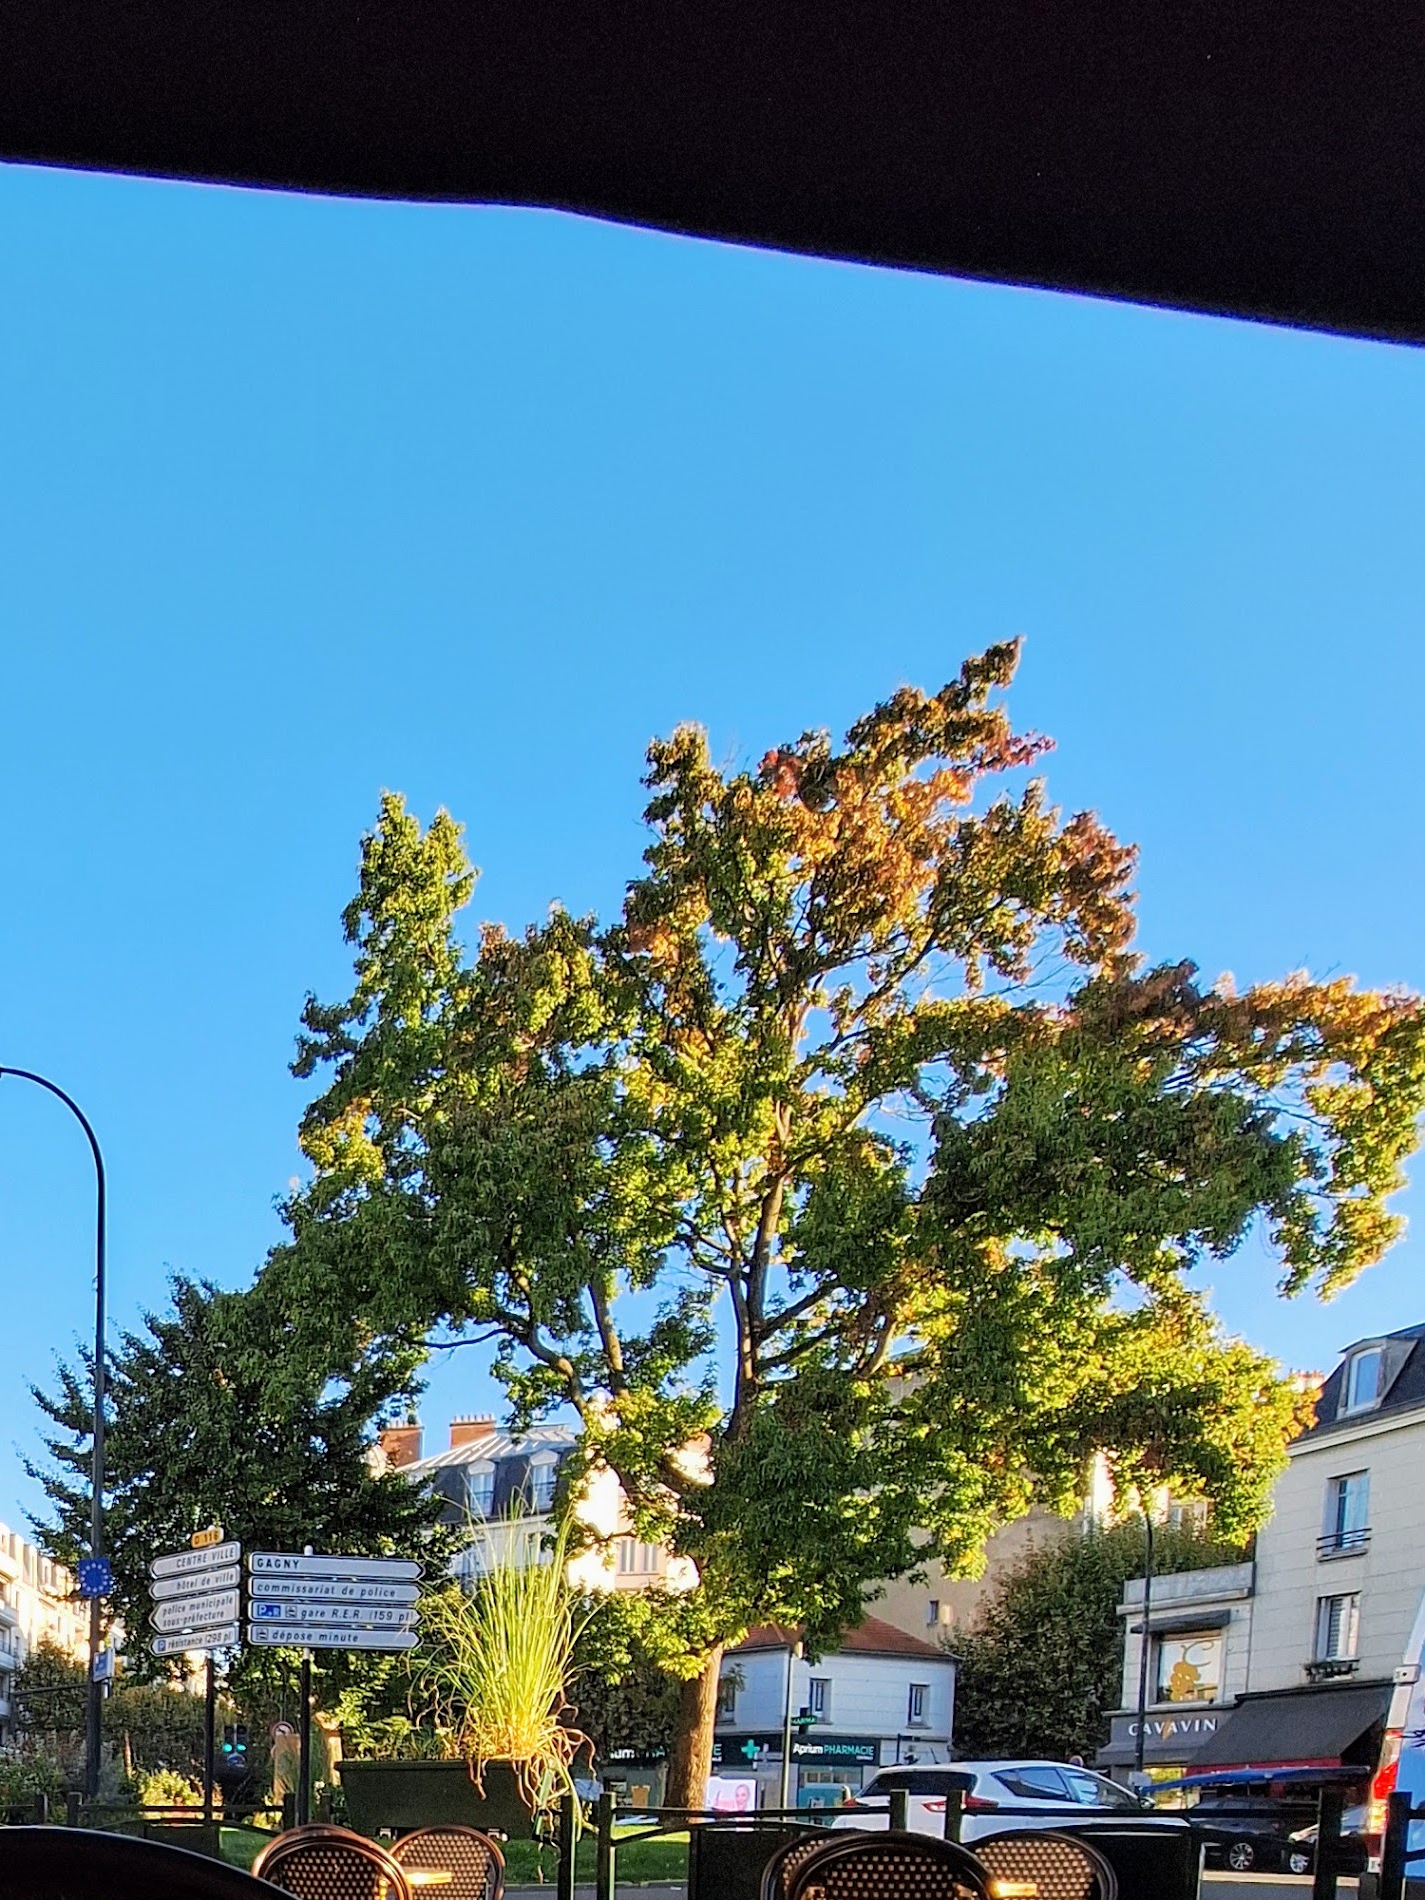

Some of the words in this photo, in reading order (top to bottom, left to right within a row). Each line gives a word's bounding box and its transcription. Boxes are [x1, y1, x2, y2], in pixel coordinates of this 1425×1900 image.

[177, 1553, 207, 1568] CENTRE
[212, 1547, 234, 1561] VILLE
[257, 1558, 299, 1569] GAGNY
[176, 1578, 198, 1591] hôtel
[201, 1577, 211, 1587] de
[215, 1571, 234, 1585] ville
[257, 1581, 335, 1595] commissariat
[341, 1586, 354, 1596] de
[360, 1585, 396, 1599] police
[163, 1603, 186, 1617] police
[189, 1595, 233, 1611] municipale
[301, 1609, 326, 1620] gare
[331, 1608, 363, 1619] R.E.R.
[163, 1611, 224, 1627] sous-préfecture
[168, 1636, 203, 1649] résistance
[272, 1629, 313, 1643] dépose
[318, 1631, 359, 1643] minute
[1128, 1718, 1217, 1736] CAVAVIN
[824, 1744, 874, 1756] PHARMACIE
